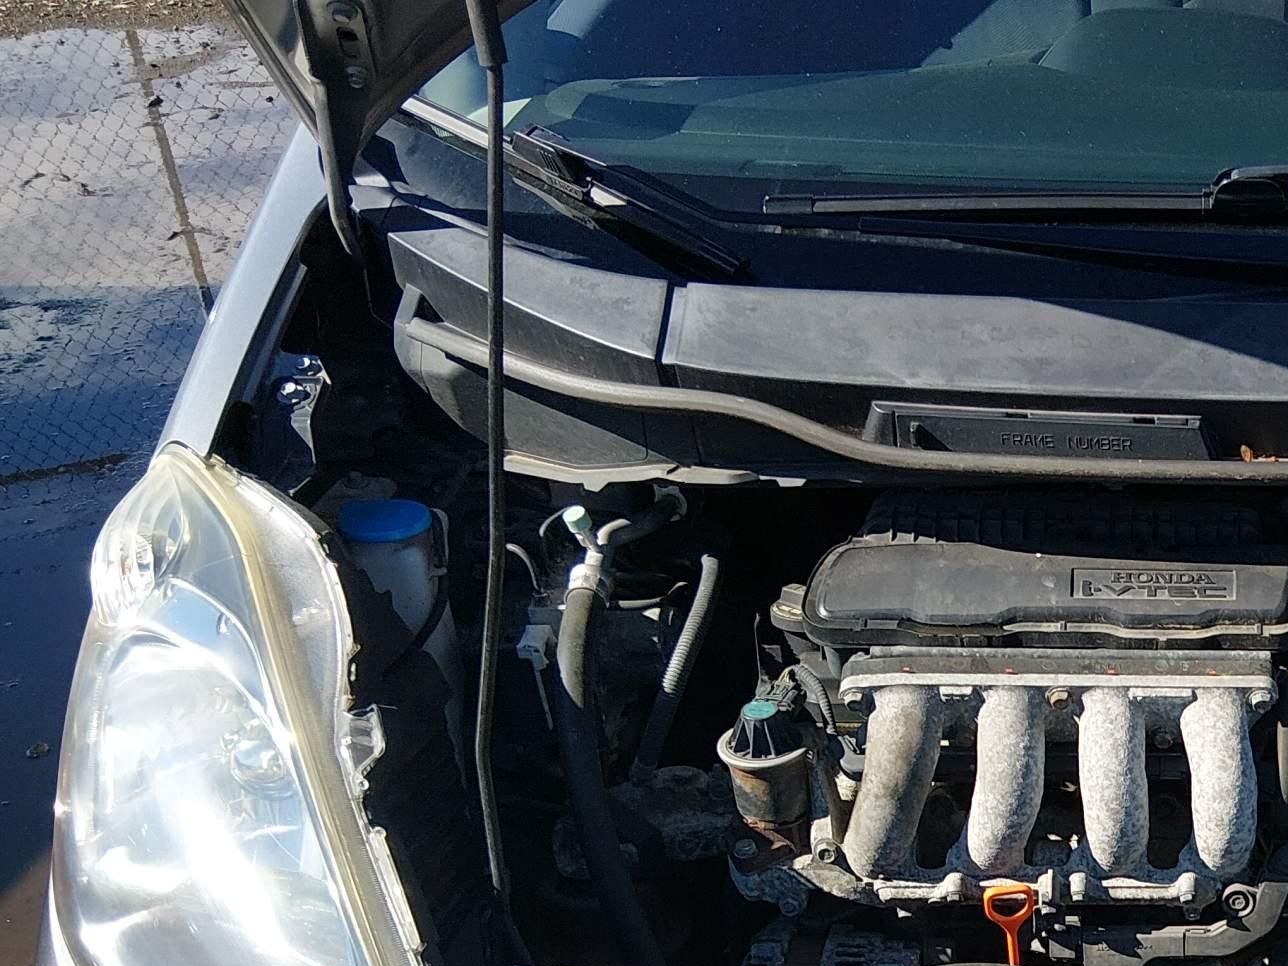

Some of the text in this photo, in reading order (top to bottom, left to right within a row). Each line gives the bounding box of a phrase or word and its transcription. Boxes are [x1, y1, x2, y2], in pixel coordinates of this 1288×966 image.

[1000, 431, 1133, 452] FRAME NUMBER
[1110, 571, 1217, 585] HONDA
